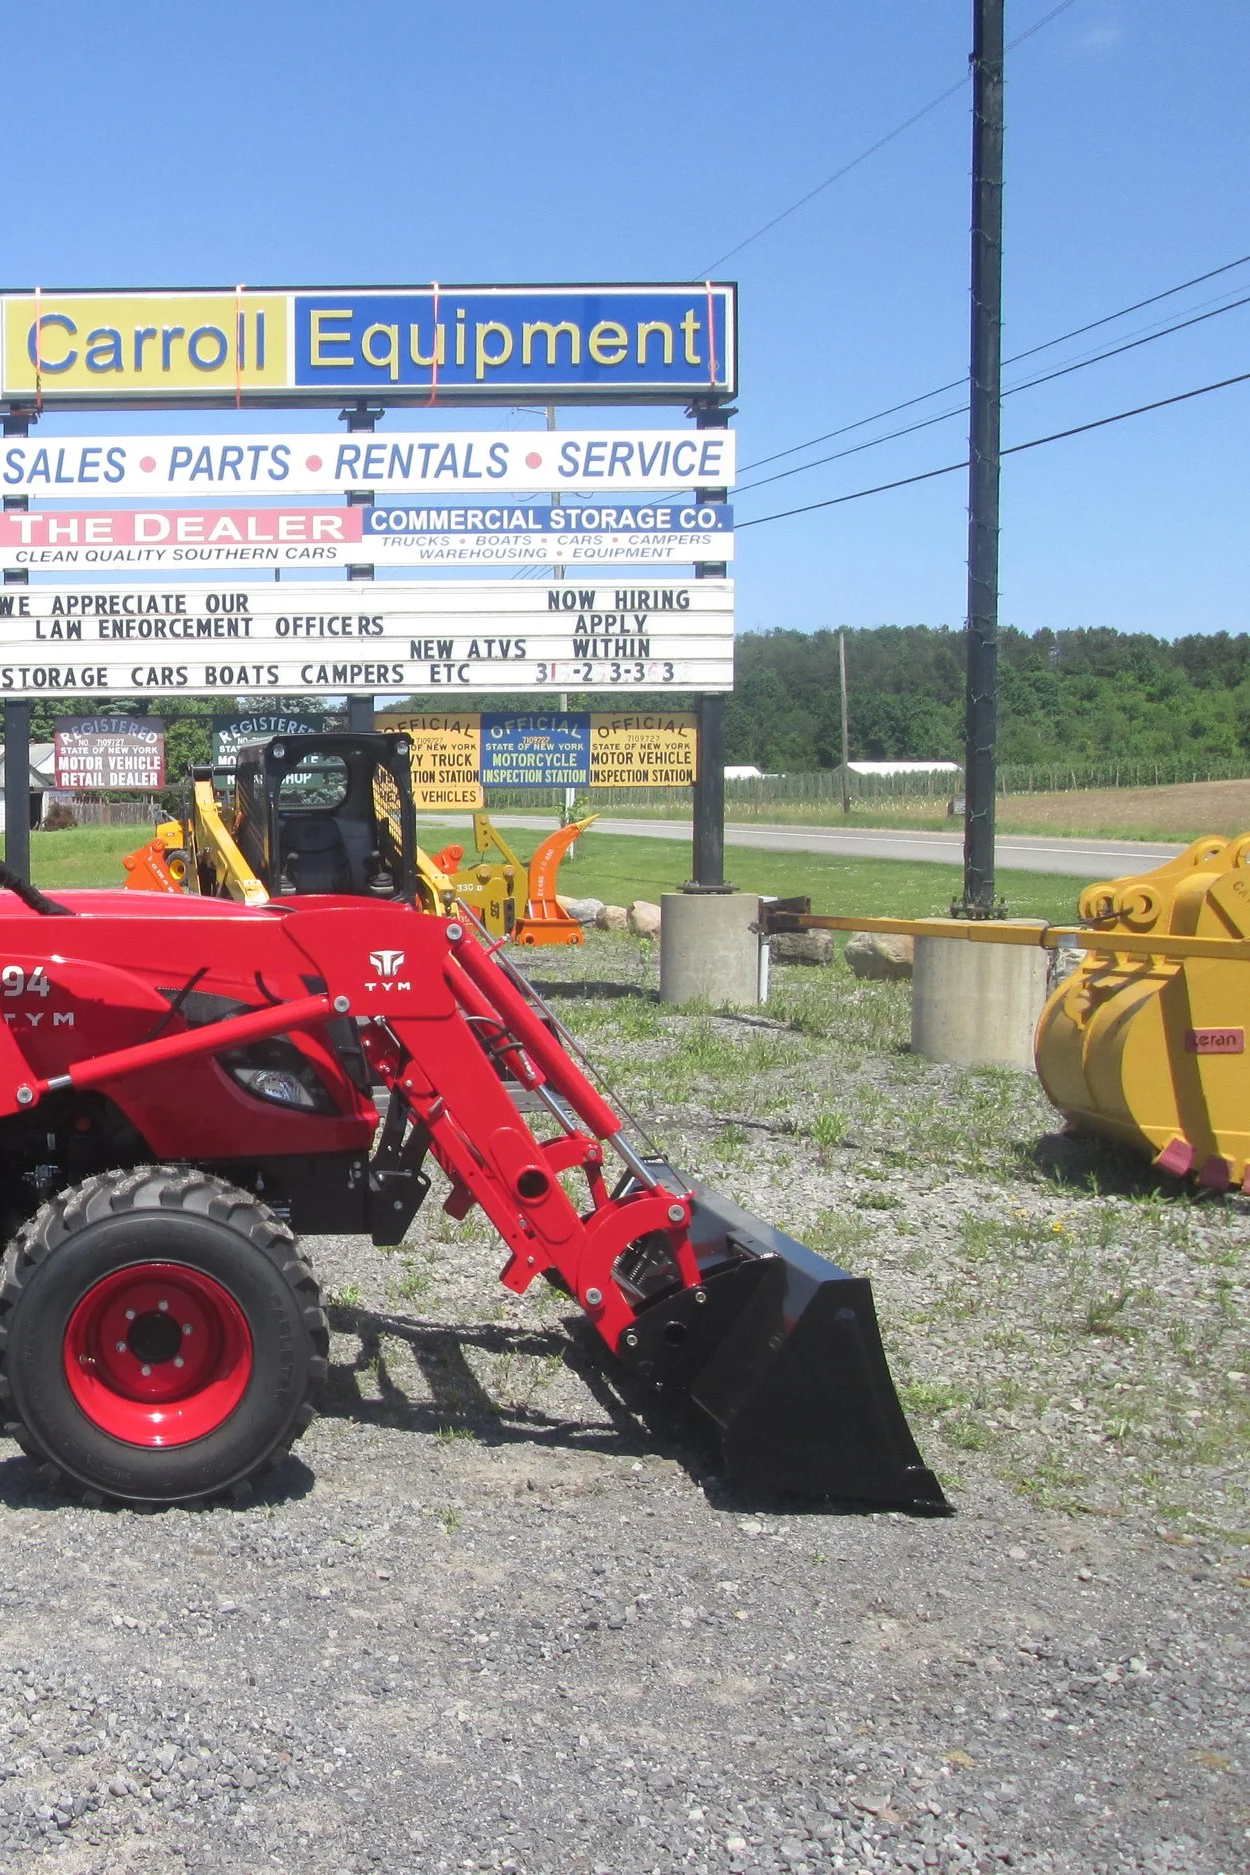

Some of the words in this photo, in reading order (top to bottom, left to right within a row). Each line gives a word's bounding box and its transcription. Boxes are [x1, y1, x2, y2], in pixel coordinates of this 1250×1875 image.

[27, 309, 265, 373] Carroll
[309, 308, 701, 381] Equipment
[3, 447, 126, 484] SALES
[168, 445, 291, 481] PARTS
[334, 441, 510, 479] RENTALS
[557, 440, 724, 477] SERVICE
[370, 509, 542, 531] COMMERCIAL
[550, 508, 670, 530] STORAGE
[679, 507, 723, 529] CO.
[9, 515, 113, 544] THE
[134, 513, 345, 543] DEALER
[382, 536, 450, 547] TRUCKS
[475, 536, 532, 546] BOATS
[557, 535, 603, 545] CARS
[628, 534, 712, 545] CAMPERS
[16, 550, 79, 563] CLEAN
[85, 549, 167, 563] QUALITY
[172, 548, 279, 561] SOUTHERN
[285, 547, 338, 560] CARS
[419, 548, 548, 559] WAREHOUSING
[572, 547, 675, 558] EQUIPMENT
[51, 594, 187, 615] APPRECIATE
[205, 593, 250, 613] OUR
[548, 590, 595, 610] NOW
[615, 590, 690, 610] HIRING
[35, 619, 82, 639] LAW
[99, 617, 253, 639] ENFORCEMENT
[275, 616, 384, 637] OFFICERS
[574, 614, 648, 634] APPLY
[410, 640, 454, 659] NEW
[467, 639, 526, 659] ATVS
[573, 638, 650, 658] WITHIN
[2, 667, 108, 688] STORAGE
[131, 666, 188, 686] CARS
[205, 665, 280, 685] BOATS
[301, 664, 404, 684] CAMPERS
[430, 663, 470, 683] ETC
[60, 718, 158, 745] REGISTERED
[219, 716, 316, 744] REGISTERE
[491, 717, 582, 739] OFFICIAL
[597, 717, 688, 739] OFFICIAL
[132, 746, 158, 754] YORK
[485, 743, 514, 751] STATE
[517, 743, 530, 751] OF
[533, 743, 555, 751] NEW
[558, 743, 584, 751] YORK
[665, 742, 690, 750] YORK
[58, 756, 103, 770] MOTOR
[108, 756, 161, 770] VEHICLE
[431, 754, 472, 767] TRUCK
[492, 753, 577, 767] MOTORCYCLE
[591, 752, 634, 765] MOTOR
[638, 751, 692, 765] VEHICLE
[61, 772, 105, 786] RETAIL
[110, 772, 158, 786] DEALER
[438, 770, 480, 783] STATION
[483, 769, 542, 783] INSPECTION
[545, 769, 586, 783] STATION
[590, 769, 649, 783] INSPECTION
[652, 769, 693, 782] STATION
[422, 790, 477, 803] VEHICLES
[456, 884, 474, 892] 330
[364, 981, 411, 992] TYM
[4, 1012, 75, 1026] TYM
